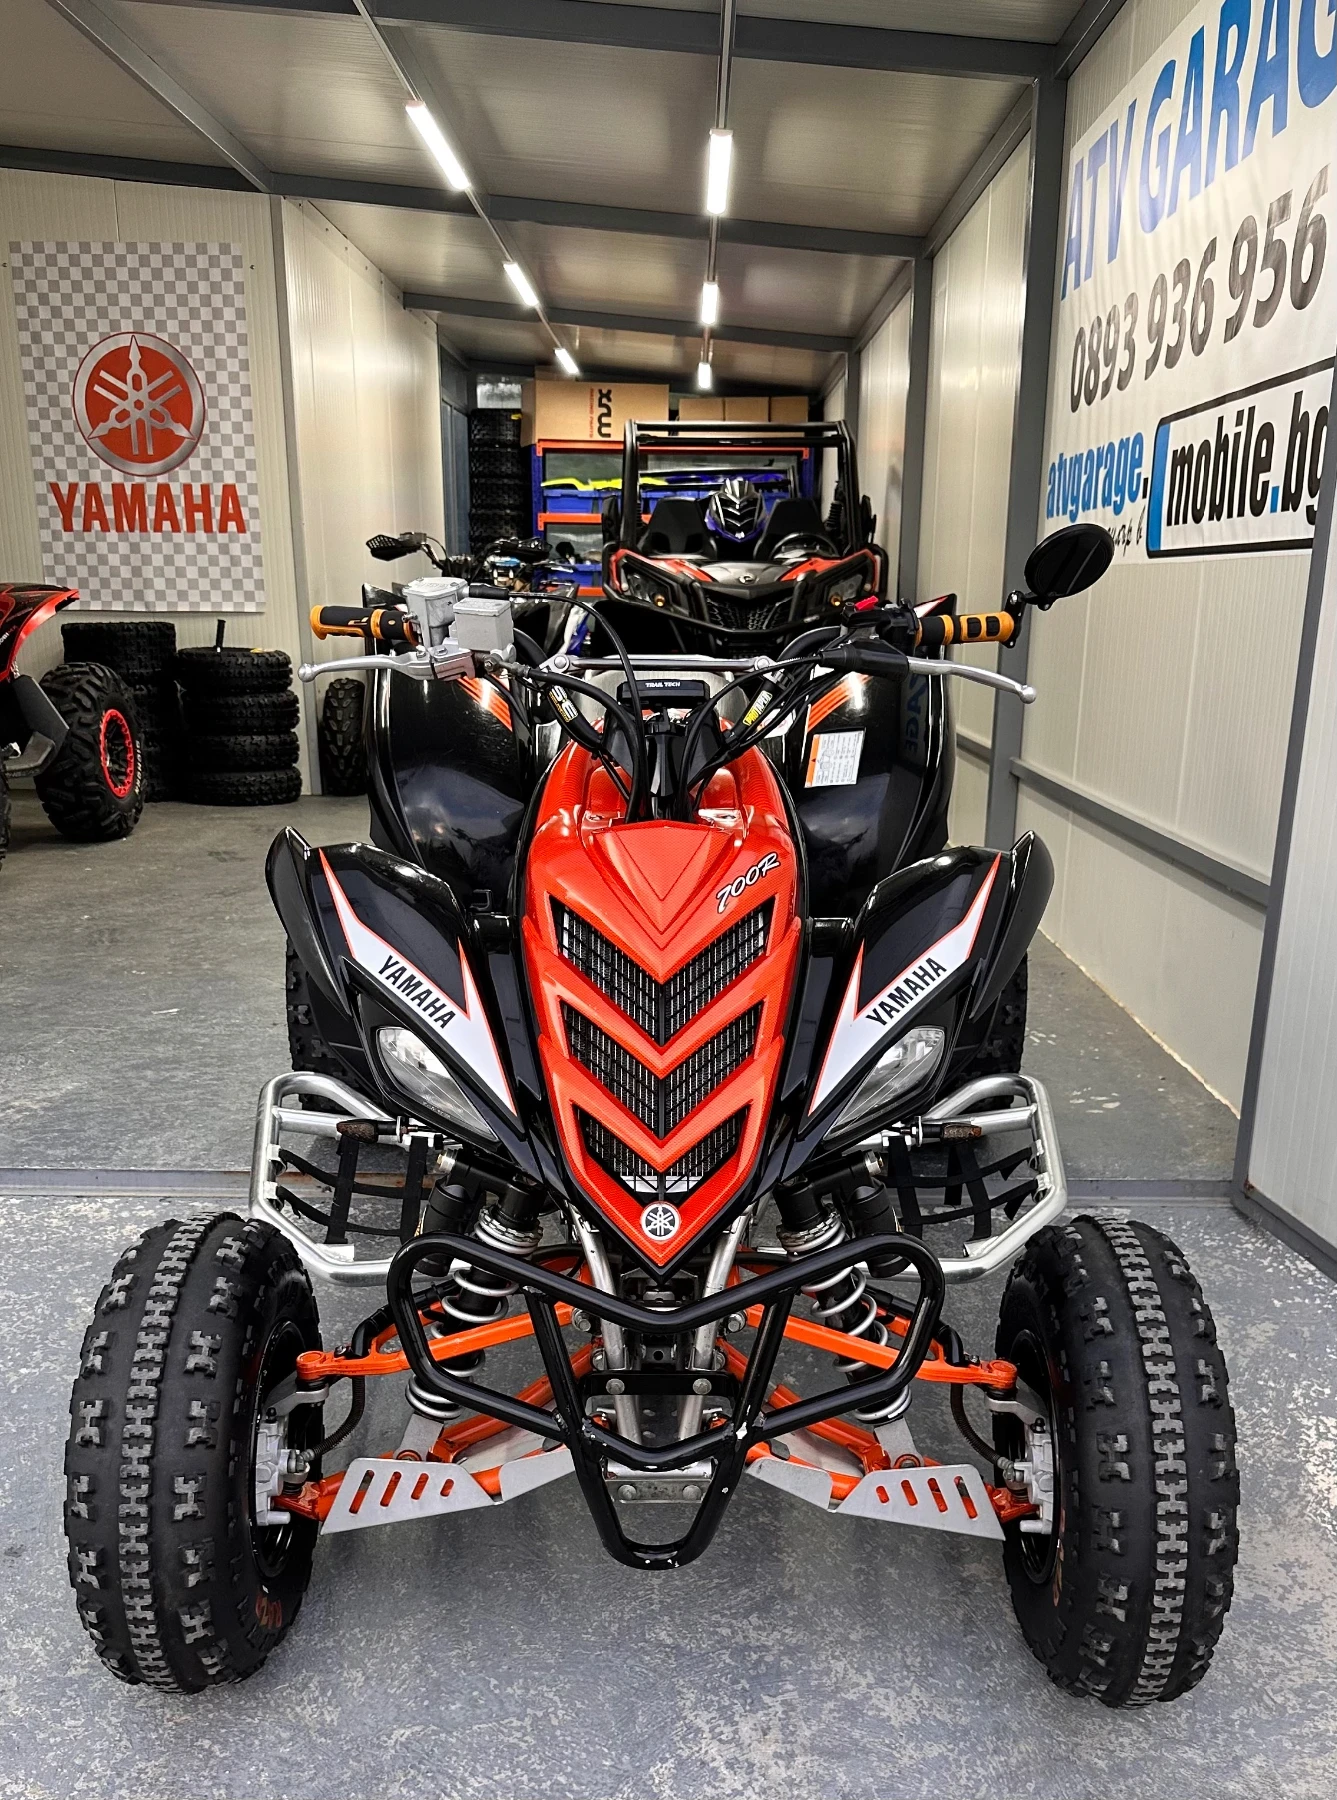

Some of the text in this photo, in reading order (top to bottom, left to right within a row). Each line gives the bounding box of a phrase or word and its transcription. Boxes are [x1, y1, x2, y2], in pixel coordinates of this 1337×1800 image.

[1061, 98, 1137, 302] ATV
[1070, 162, 1331, 414] 0893 936 956
[1166, 390, 1329, 527] mobile.bg
[49, 482, 247, 534] YAMAHA
[716, 852, 781, 914] 700R
[378, 955, 456, 1029] YAMAHA
[865, 957, 947, 1026] YAMAHA
